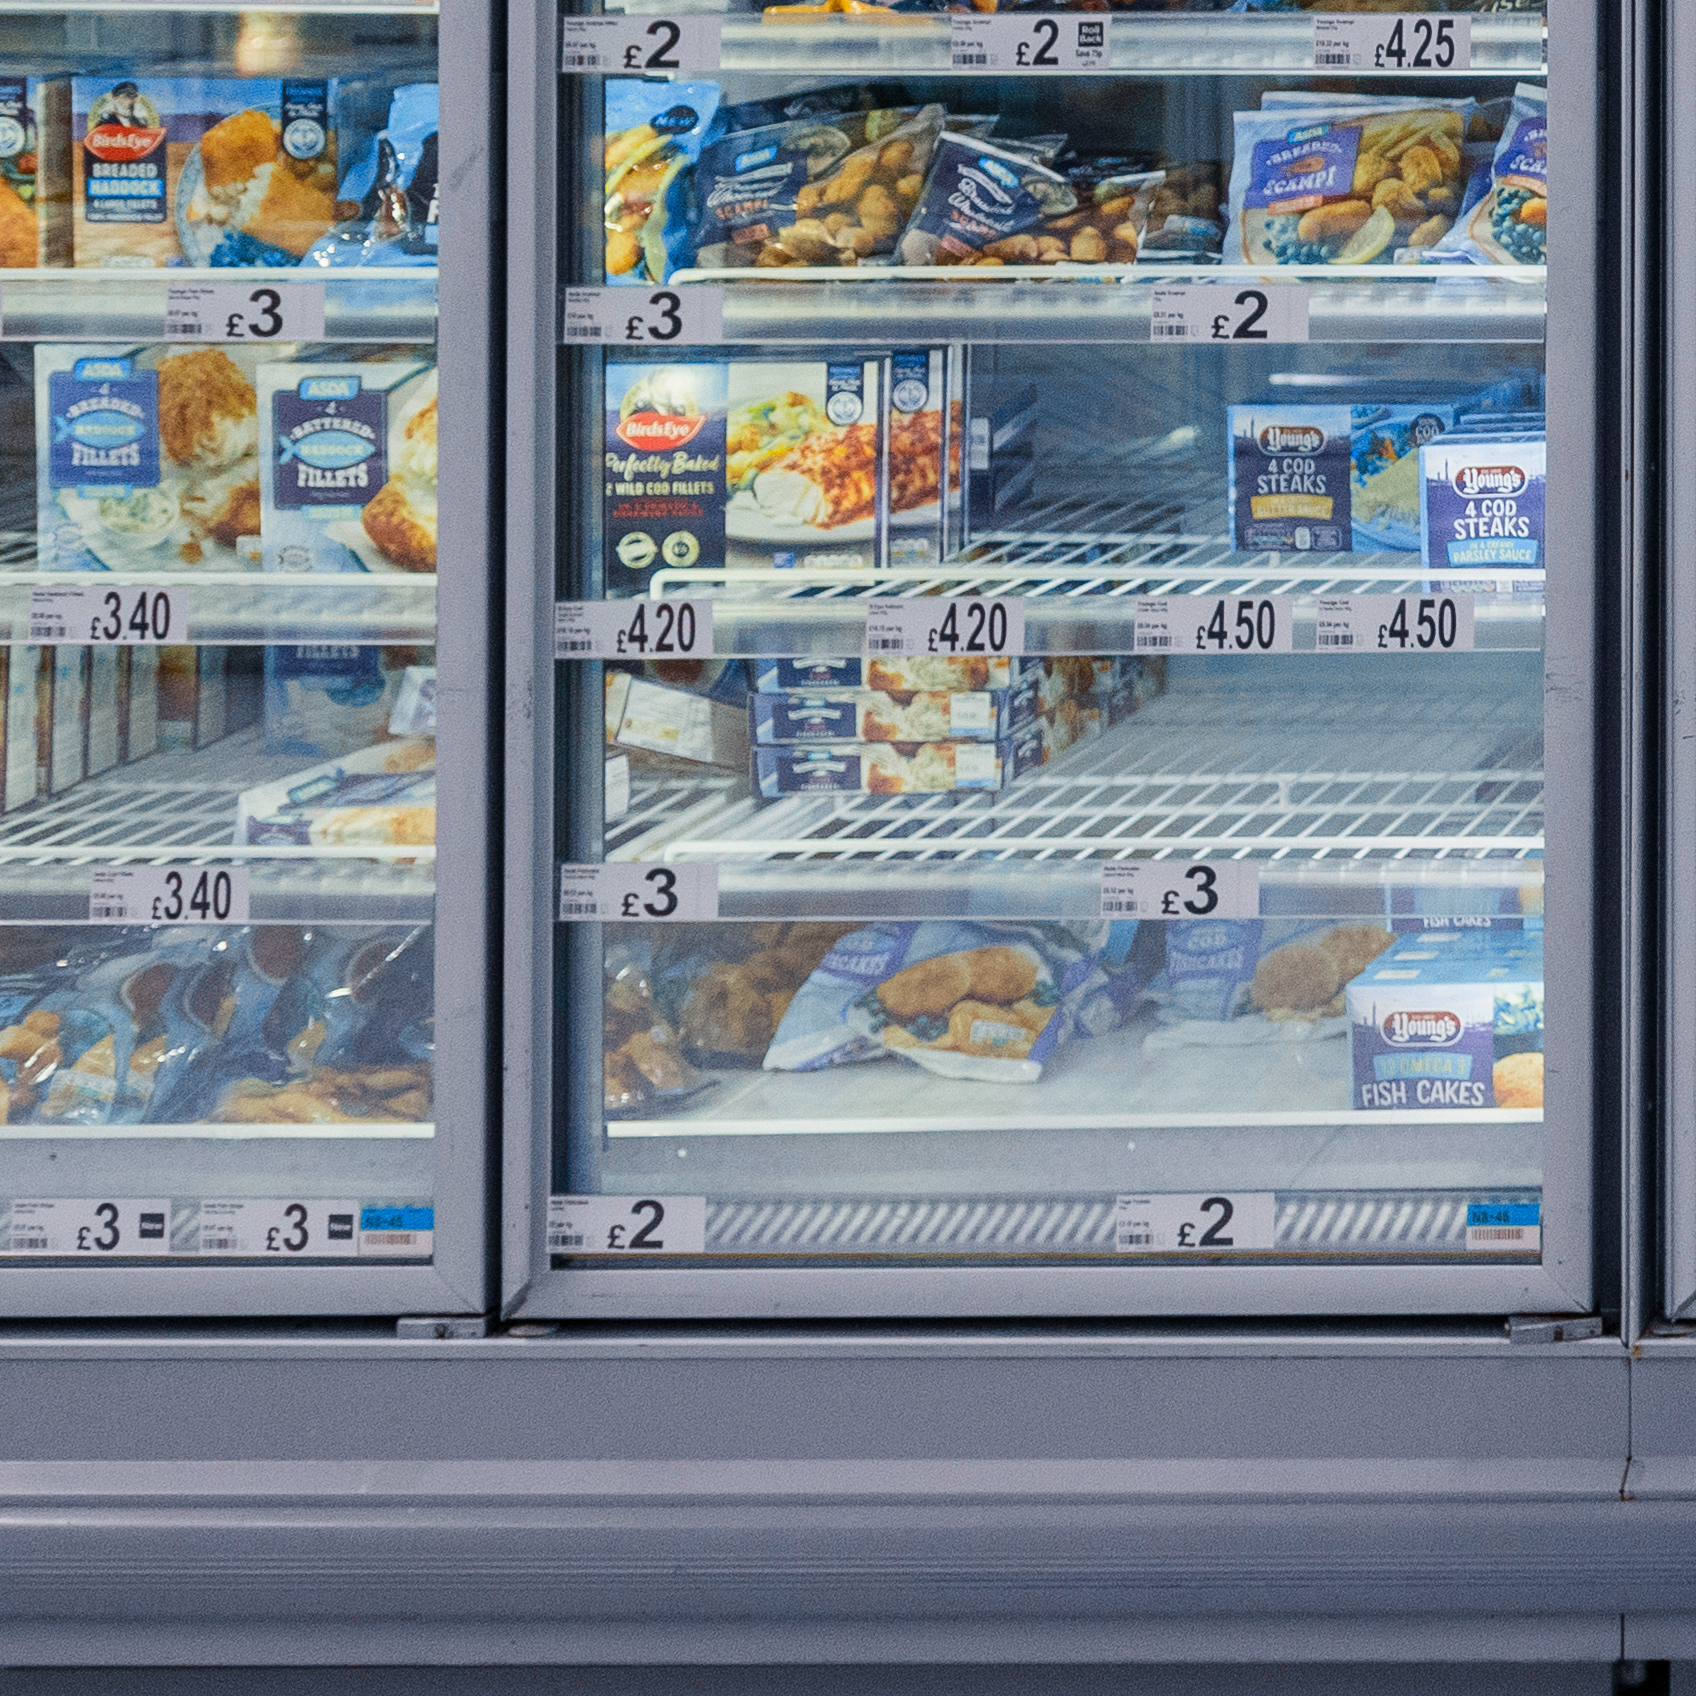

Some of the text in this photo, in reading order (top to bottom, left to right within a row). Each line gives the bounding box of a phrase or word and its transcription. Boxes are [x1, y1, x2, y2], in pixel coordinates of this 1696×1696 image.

[623, 20, 681, 69] £2
[1016, 19, 1059, 66] £2
[1374, 18, 1456, 68] £4.25
[89, 181, 161, 196] HADDOCK
[92, 164, 158, 177] BREADED
[1263, 171, 1338, 196] SCAMPI
[226, 289, 284, 337] £3
[625, 291, 683, 341] £3
[1210, 289, 1269, 339] £2
[307, 380, 350, 397] ASDA
[292, 418, 374, 439] BATTERED
[1266, 428, 1320, 452] Young's
[71, 443, 140, 467] FILLETS
[297, 465, 368, 488] FILLETS
[1267, 458, 1316, 475] 4 COD
[672, 480, 715, 495] FILLETS
[1256, 474, 1327, 495] STEAKS
[1461, 468, 1522, 494] Young's
[1453, 516, 1530, 540] STEAKS
[1464, 499, 1517, 518] 4 COD
[1452, 547, 1532, 564] PARSLEY SAUCE
[90, 590, 171, 641] £3.40
[616, 603, 697, 653] £4.20
[928, 602, 1008, 653] £4.20
[1196, 599, 1275, 650] £4.50
[1378, 598, 1458, 649] £4.50
[151, 870, 232, 920] £3.40
[621, 867, 678, 918] £3
[1161, 865, 1219, 916] £3
[1391, 1011, 1458, 1044] Young's
[1361, 1079, 1485, 1107] FISH CAKES
[77, 1202, 121, 1252] £3
[266, 1202, 310, 1252] £3
[606, 1200, 665, 1250] £2
[1177, 1197, 1234, 1247] £2
